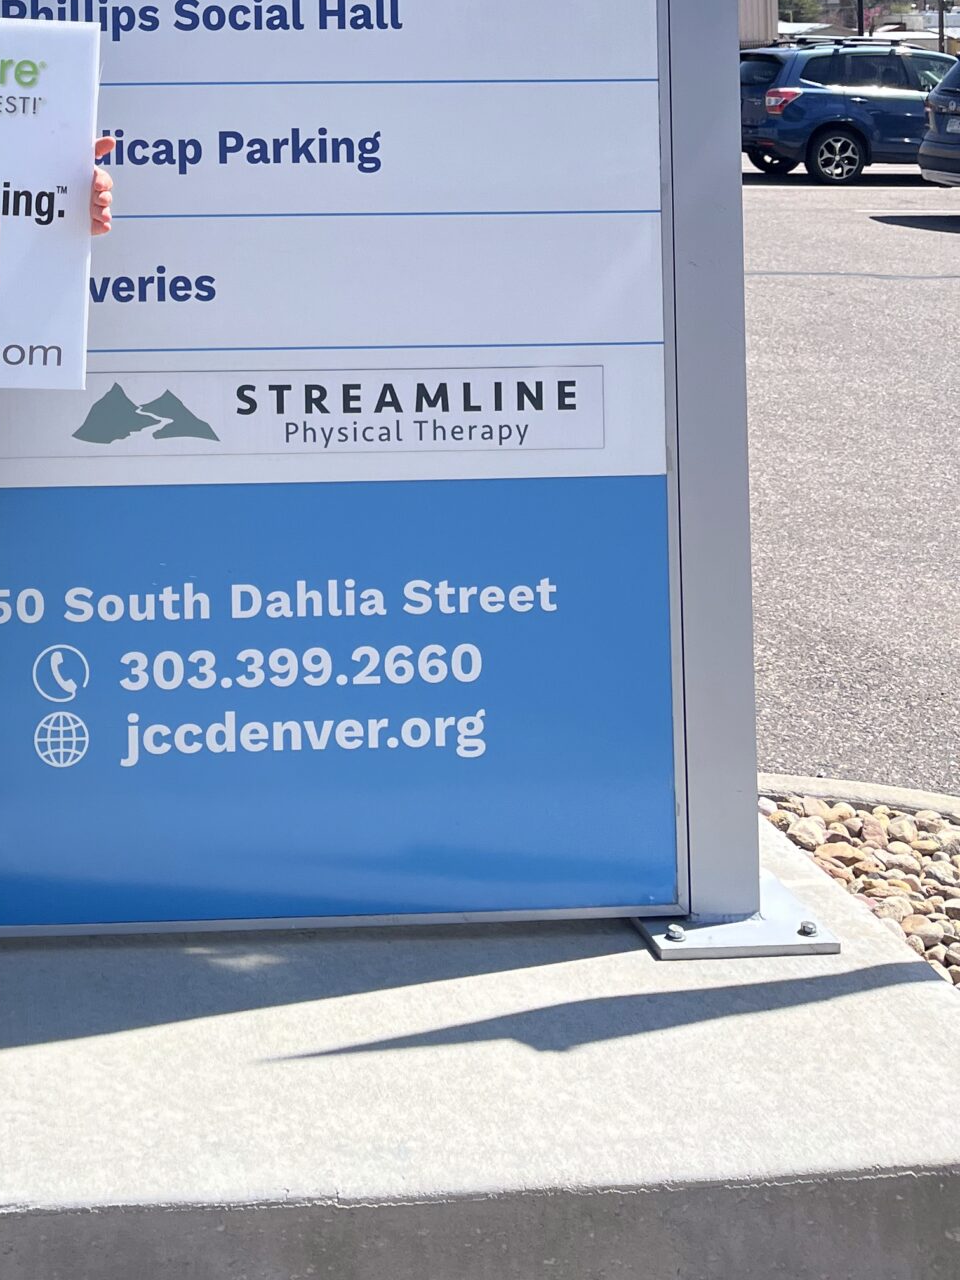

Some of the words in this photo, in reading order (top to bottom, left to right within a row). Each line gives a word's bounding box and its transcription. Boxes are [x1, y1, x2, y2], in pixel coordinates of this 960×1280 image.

[219, 128, 381, 173] Parking
[89, 265, 217, 303] veries
[237, 381, 576, 415] STREAMLINE
[286, 420, 402, 447] Physical
[414, 419, 528, 445] Therapy
[64, 583, 210, 622] South
[232, 579, 386, 618] Dahlia
[403, 578, 557, 614] Street
[120, 644, 482, 690] 303.399.2660
[121, 709, 486, 767] jccdenver.org
